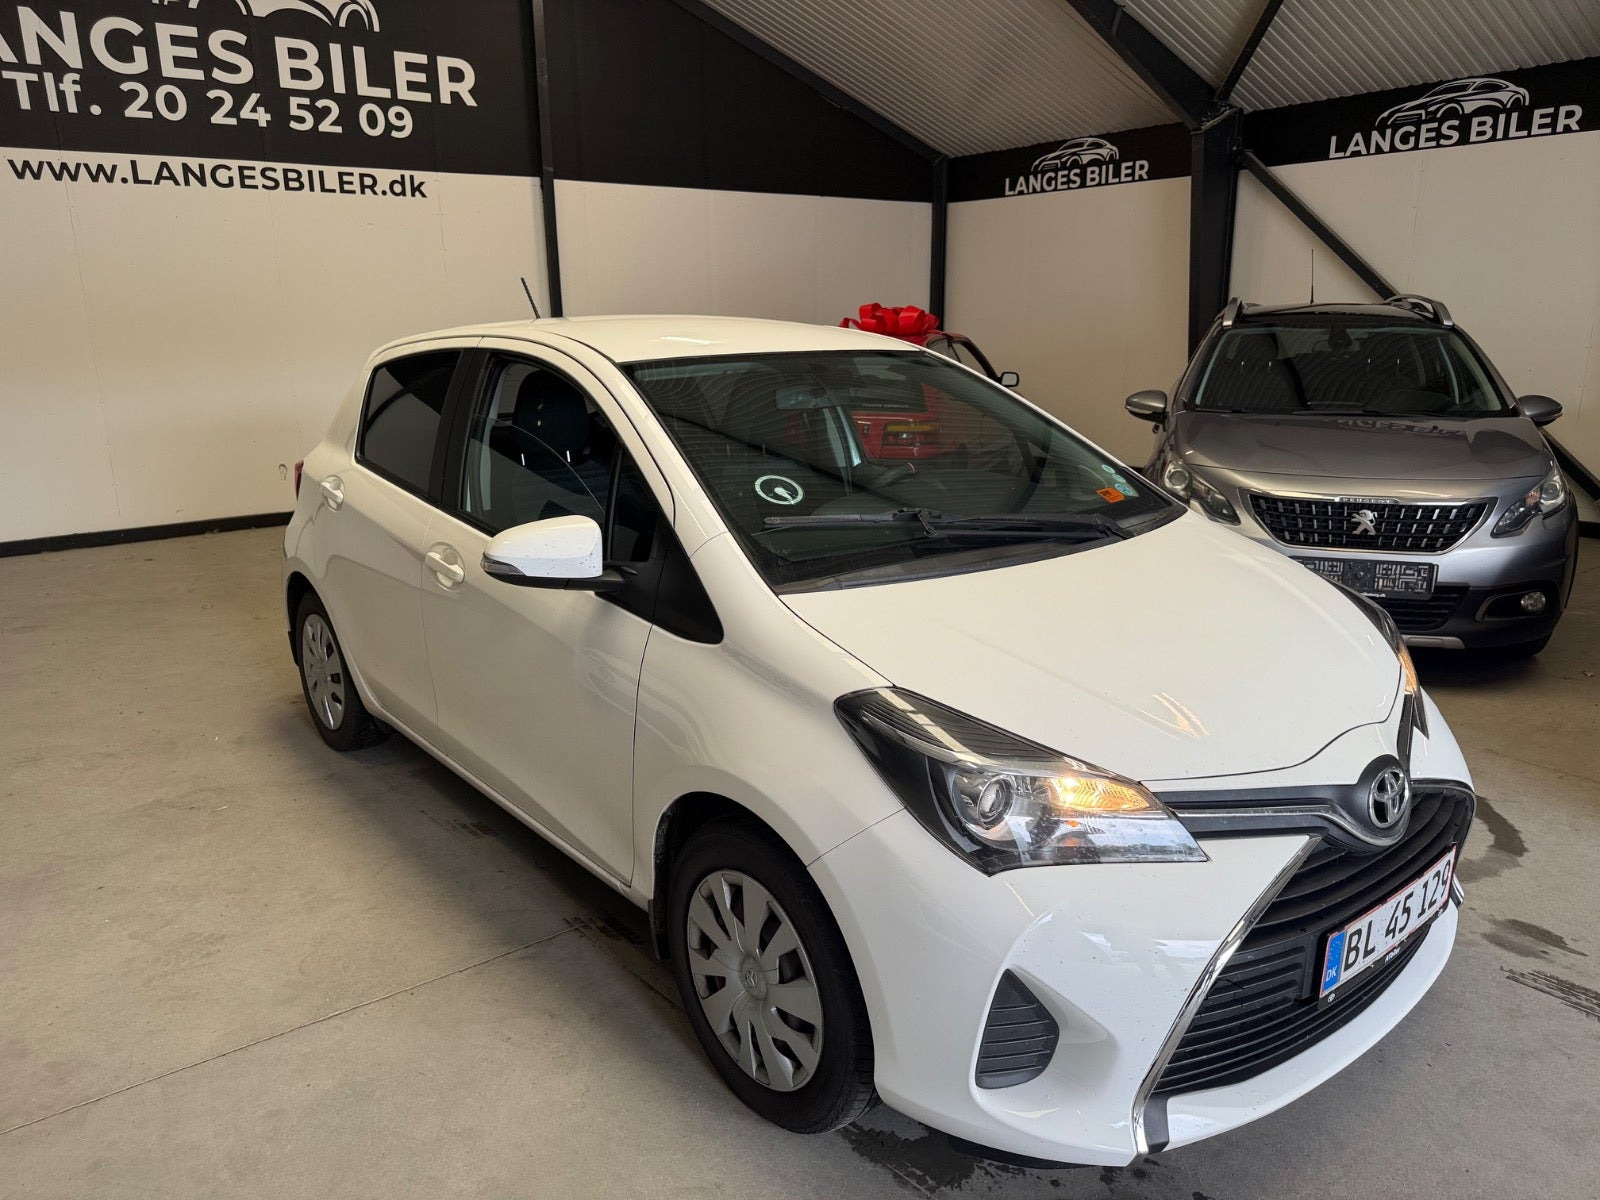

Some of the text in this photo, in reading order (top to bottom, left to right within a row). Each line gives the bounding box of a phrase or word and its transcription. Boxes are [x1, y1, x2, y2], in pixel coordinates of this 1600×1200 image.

[0, 6, 478, 107] NGES BILER
[1, 70, 413, 139] Tlf. 20 24 52 09
[1329, 104, 1583, 159] LANGES BILER
[8, 158, 428, 199] www.LANGESBILER.dk
[1004, 159, 1149, 196] LANGES BILER
[1344, 859, 1451, 972] BL 45 129
[1325, 964, 1337, 983] DK
